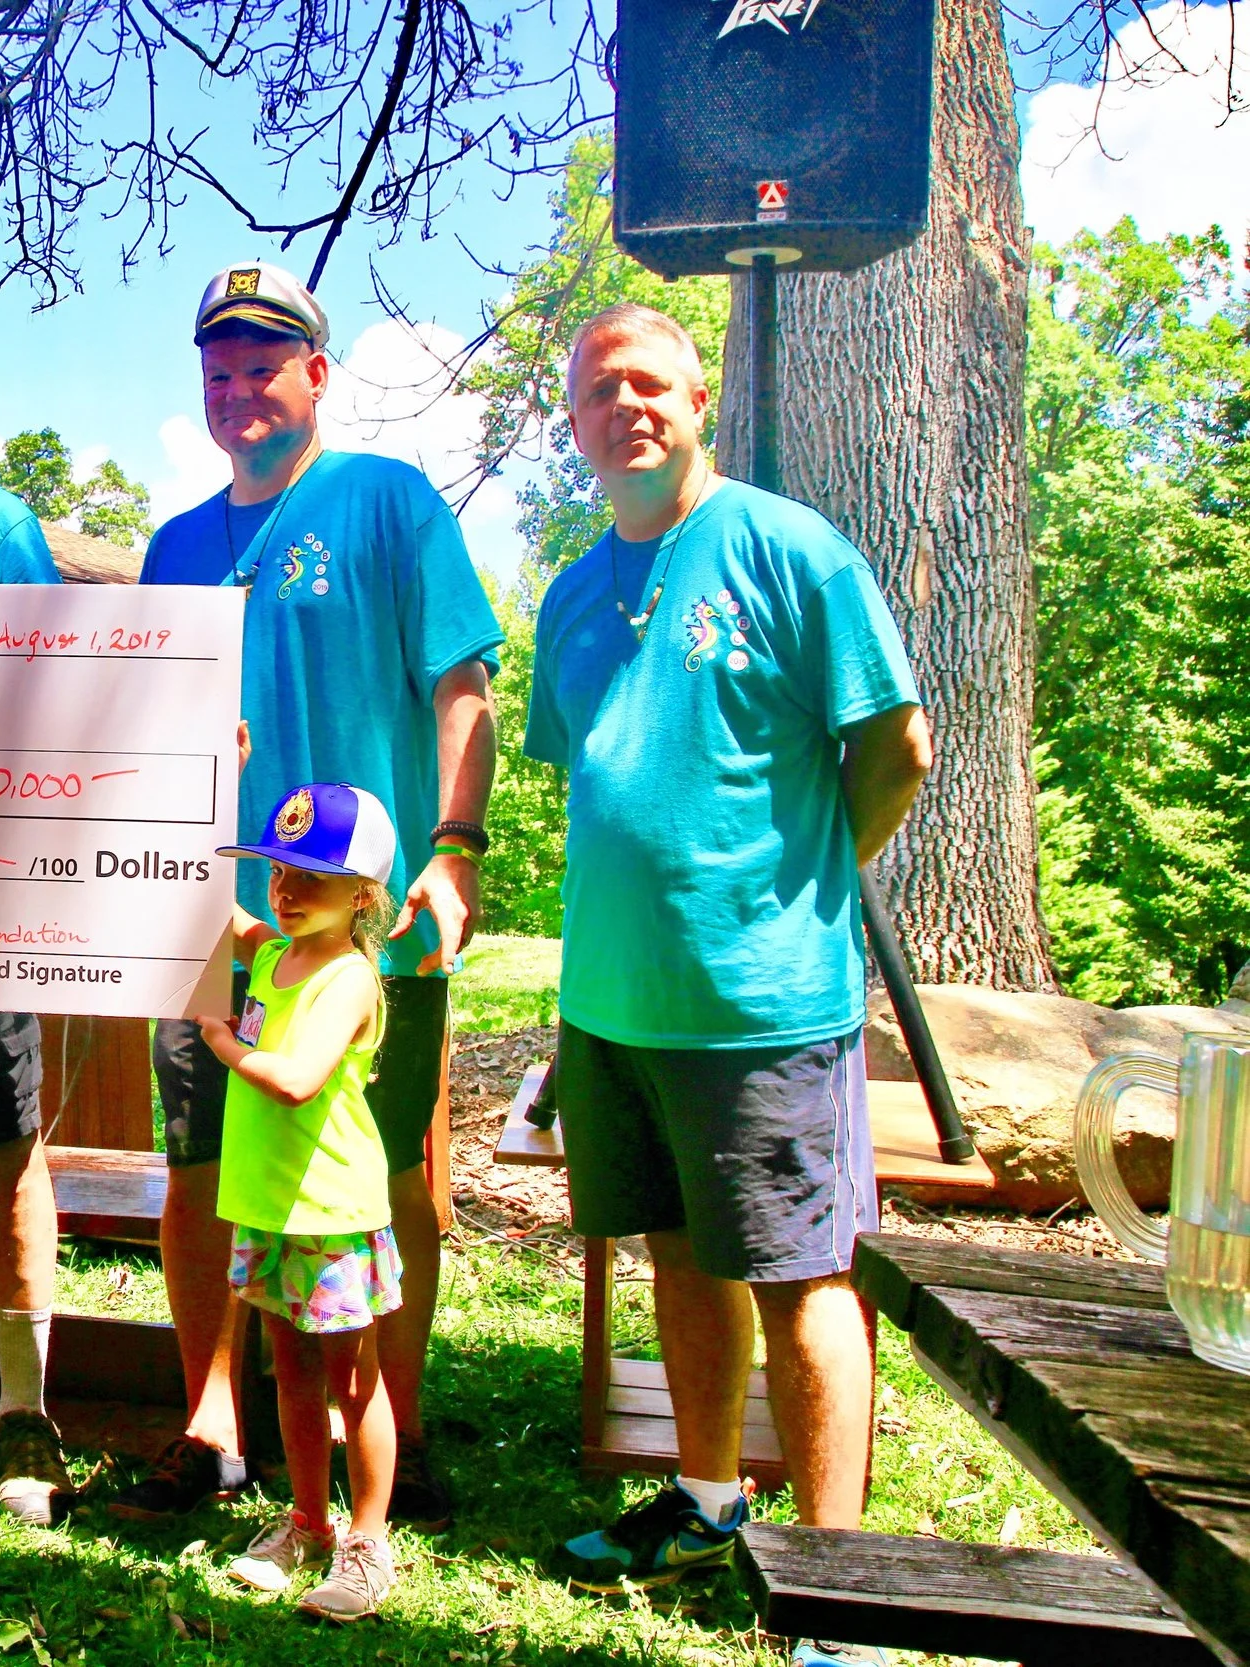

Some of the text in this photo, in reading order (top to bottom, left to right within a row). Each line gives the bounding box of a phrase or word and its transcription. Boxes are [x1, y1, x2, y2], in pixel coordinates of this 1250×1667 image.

[313, 584, 328, 592] 2019
[28, 850, 210, 881] /100 Dollars
[16, 960, 122, 986] Signature
